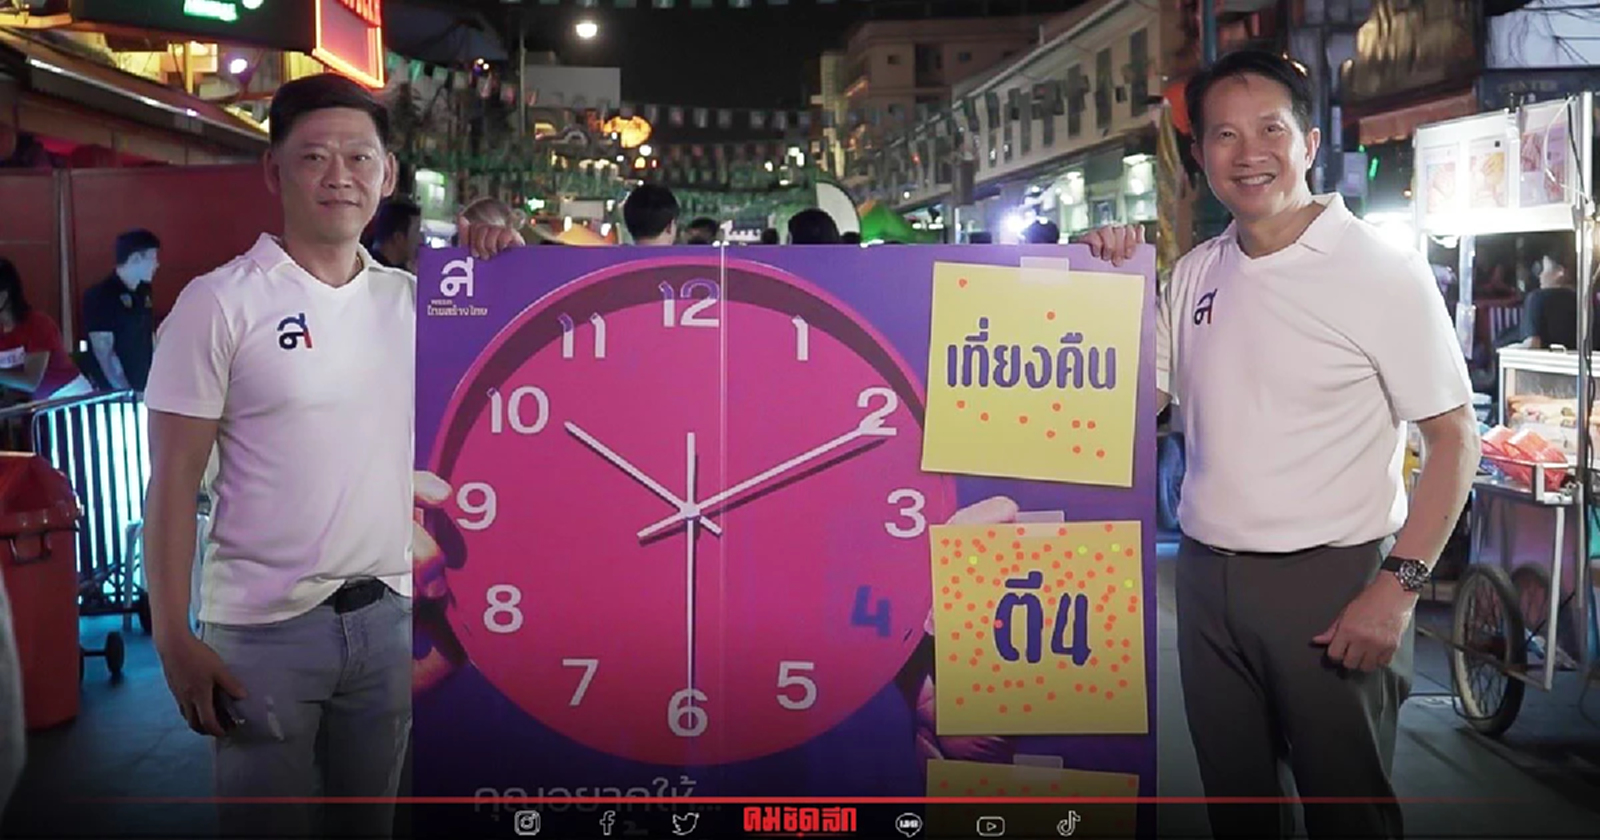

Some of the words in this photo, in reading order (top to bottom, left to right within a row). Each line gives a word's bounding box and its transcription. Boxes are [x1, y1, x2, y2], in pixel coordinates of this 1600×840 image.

[658, 278, 720, 328] 12
[557, 312, 606, 358] 11
[792, 315, 809, 361] 1
[946, 317, 1117, 390] เที่ยงคืน
[487, 386, 549, 434] 10
[857, 387, 899, 436] 2
[456, 482, 497, 530] 9
[884, 488, 926, 538] 3
[482, 584, 524, 633] 8
[851, 585, 891, 637] 4
[562, 658, 598, 706] 7
[776, 661, 817, 710] 5
[667, 688, 708, 737] 6
